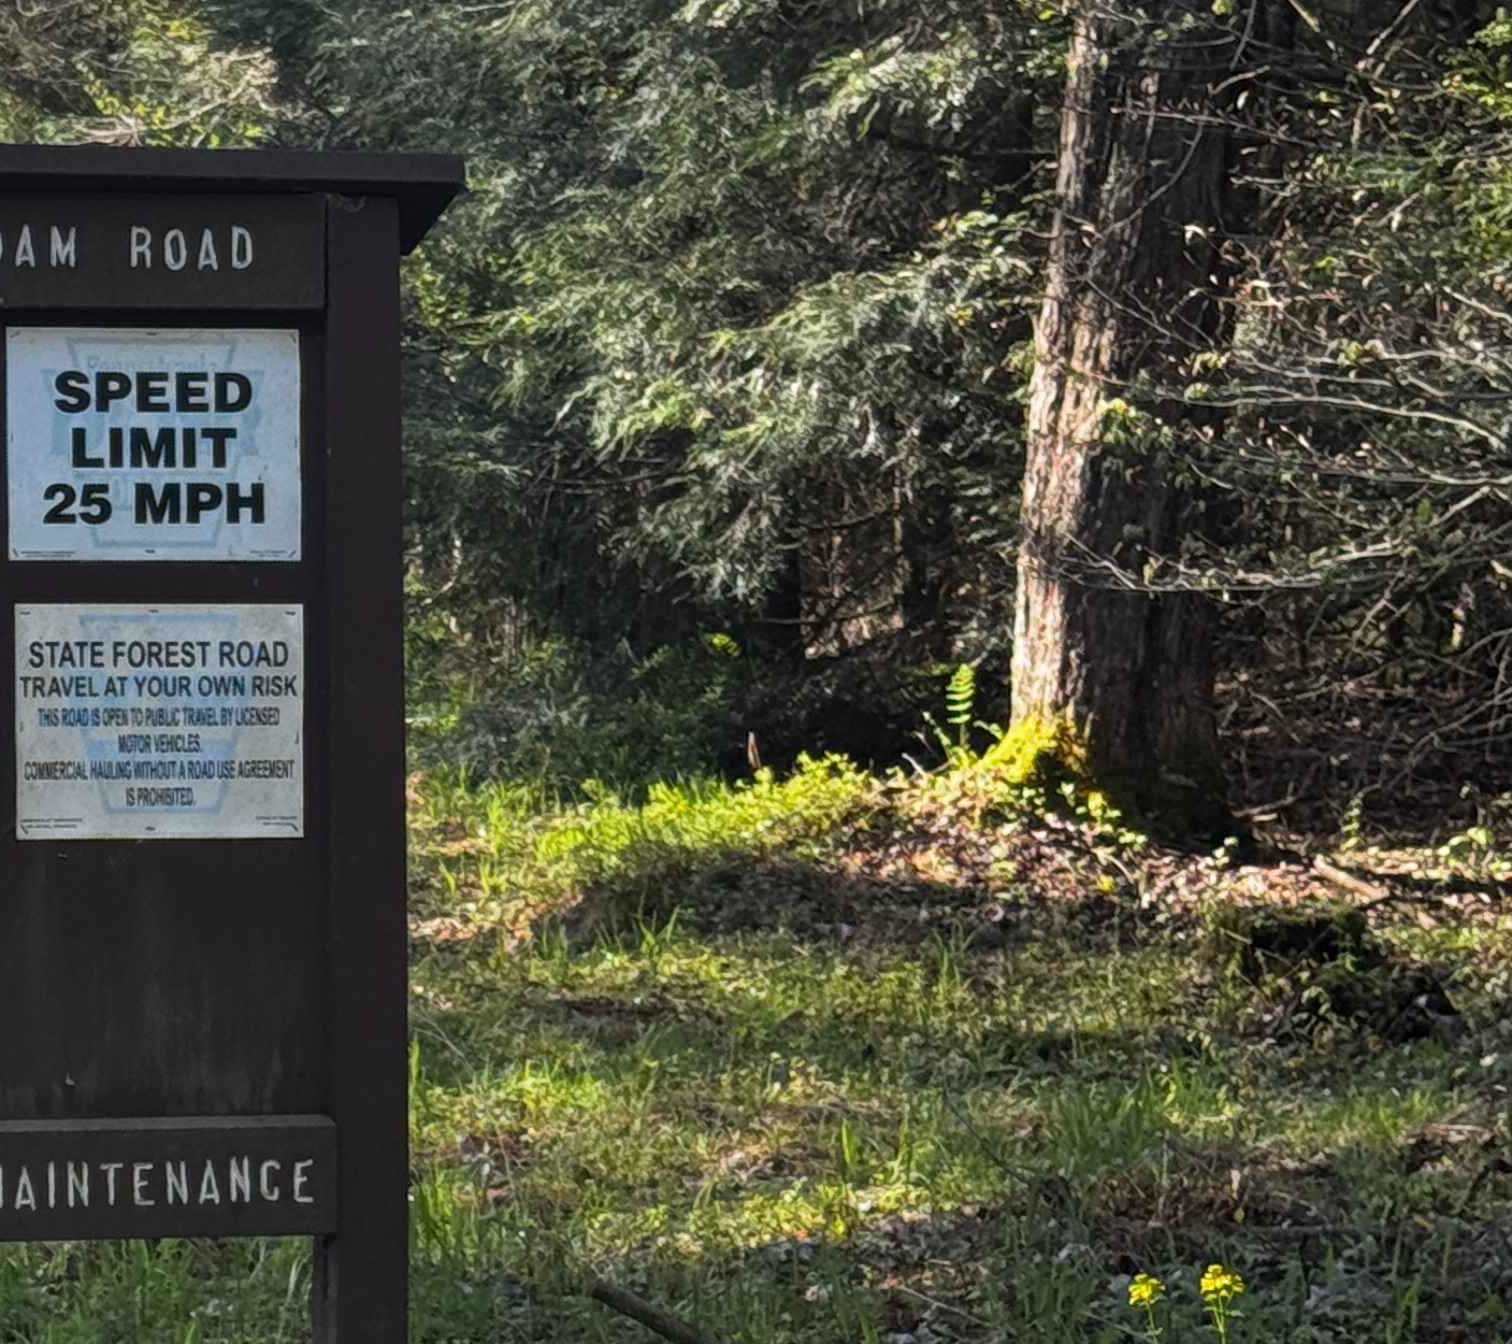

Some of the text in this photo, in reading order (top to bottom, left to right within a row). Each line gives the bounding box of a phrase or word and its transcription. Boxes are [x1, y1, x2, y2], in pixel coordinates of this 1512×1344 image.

[130, 225, 254, 271] ROAD
[54, 371, 253, 413] SPEED
[71, 427, 237, 468] LIMIT
[42, 482, 265, 524] 25 MPH
[29, 641, 289, 668] STATE FOREST ROAD
[19, 676, 298, 697] TRAVEL AT YOUR OWN RISK
[37, 707, 281, 727] THIS ROAD IS OPEN TO PUBLIC TRAVEL BY LICENSED
[118, 734, 151, 753] MOTOR
[24, 759, 295, 780] COMMERCIAL HAULING WITHOUT A ROAD USE AGREEMENT
[125, 787, 136, 807] IS
